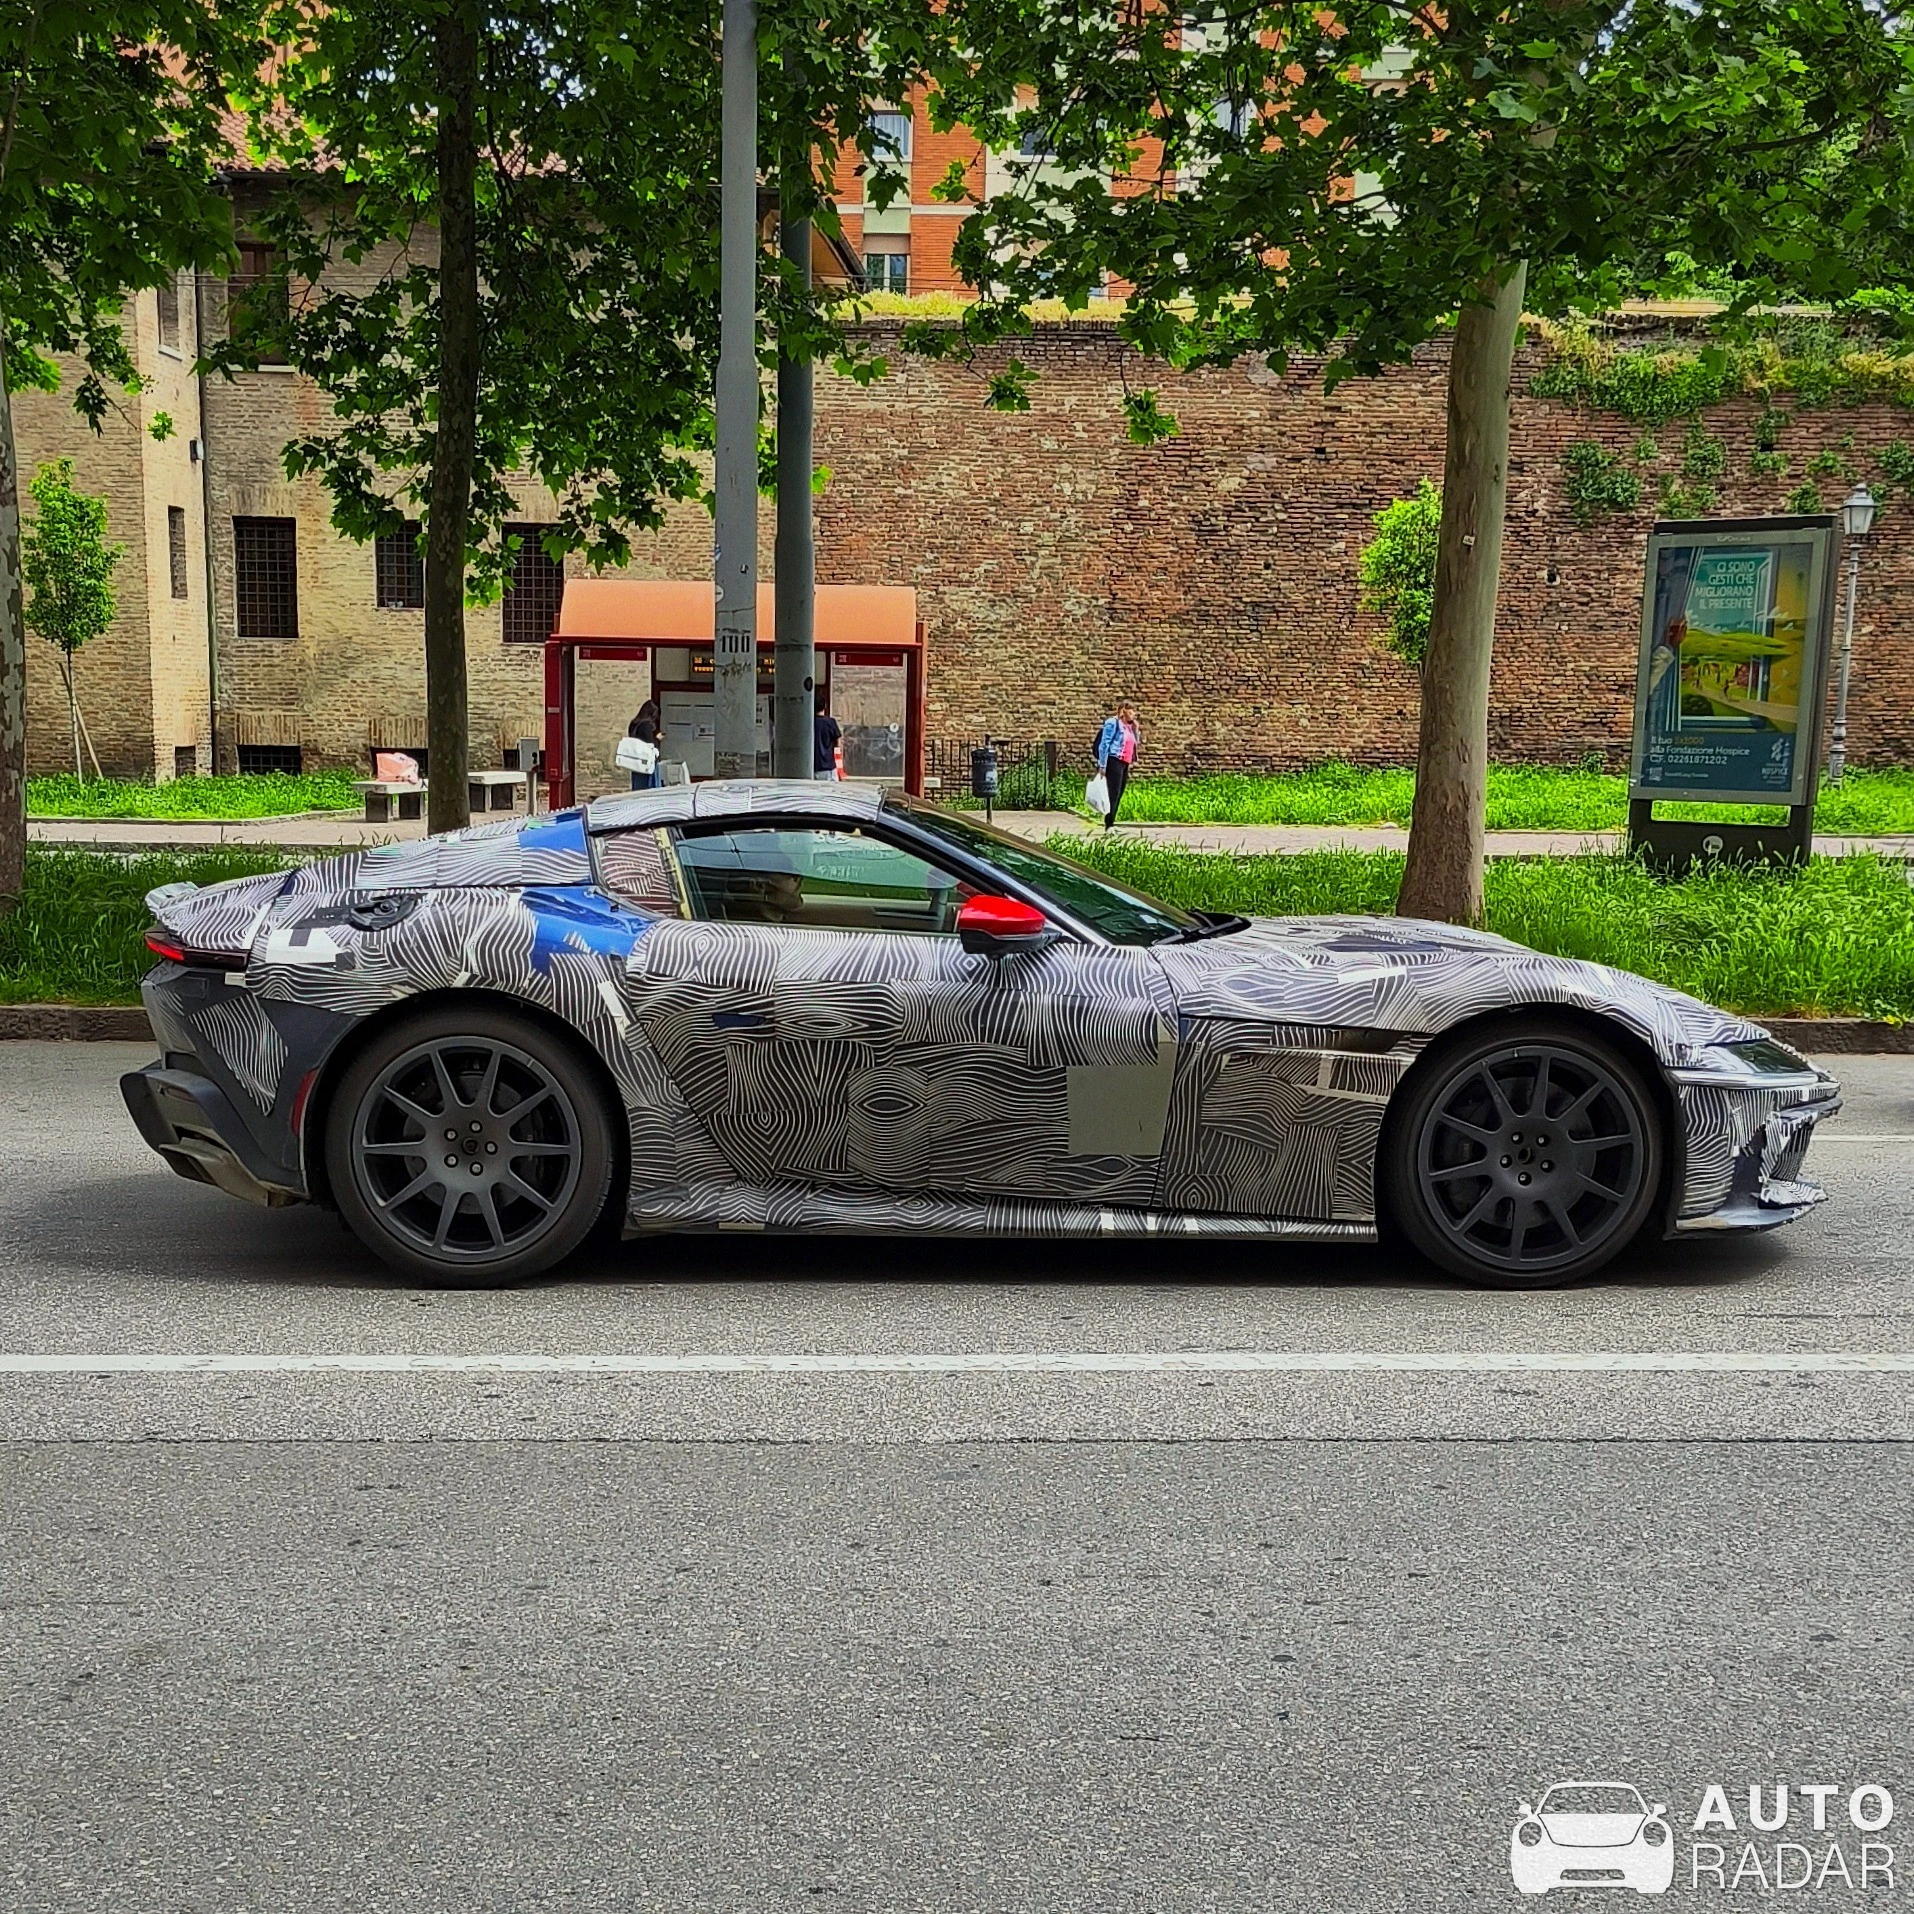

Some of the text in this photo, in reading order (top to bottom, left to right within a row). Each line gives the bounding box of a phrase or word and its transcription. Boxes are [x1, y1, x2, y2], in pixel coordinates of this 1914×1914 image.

[1728, 561, 1755, 573] SONO
[1708, 573, 1755, 585] GESTI CHE
[1695, 585, 1754, 598] MIGLIORANO
[1709, 598, 1753, 609] PRESENTE
[1658, 735, 1673, 744] tuo
[1666, 745, 1714, 755] Fondazione
[1715, 746, 1750, 757] Hospice
